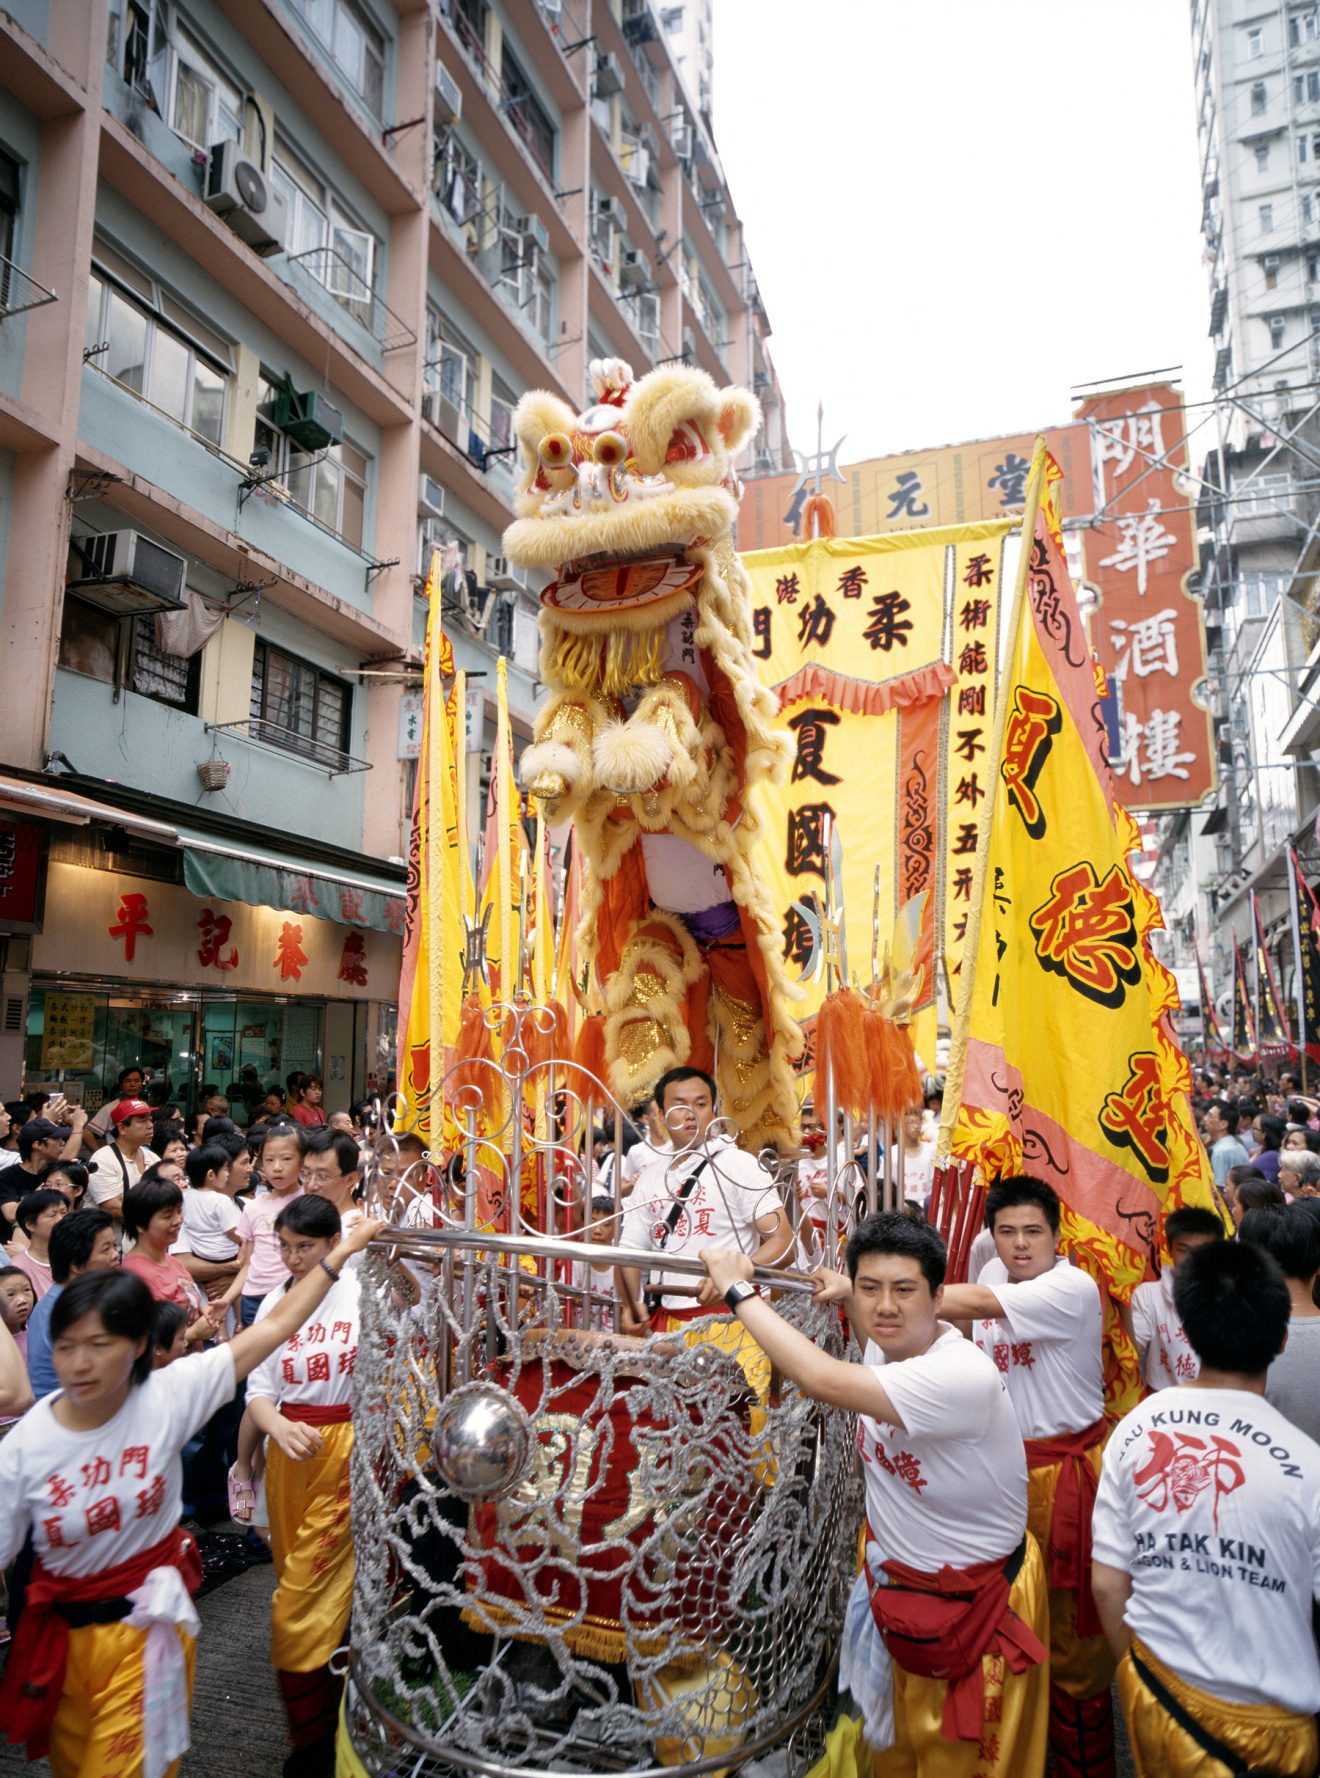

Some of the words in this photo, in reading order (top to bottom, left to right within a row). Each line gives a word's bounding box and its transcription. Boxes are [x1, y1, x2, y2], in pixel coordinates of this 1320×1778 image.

[775, 565, 870, 606] 香港
[1097, 399, 1196, 787] 明華酒樓
[1151, 1410, 1221, 1428] KUNG
[1229, 1418, 1305, 1481] MOON
[1165, 1532, 1211, 1556] TAK
[1219, 1536, 1267, 1569] KIN
[1180, 1557, 1192, 1571] &
[1196, 1558, 1233, 1580] LION
[1238, 1566, 1287, 1594] TEAM
